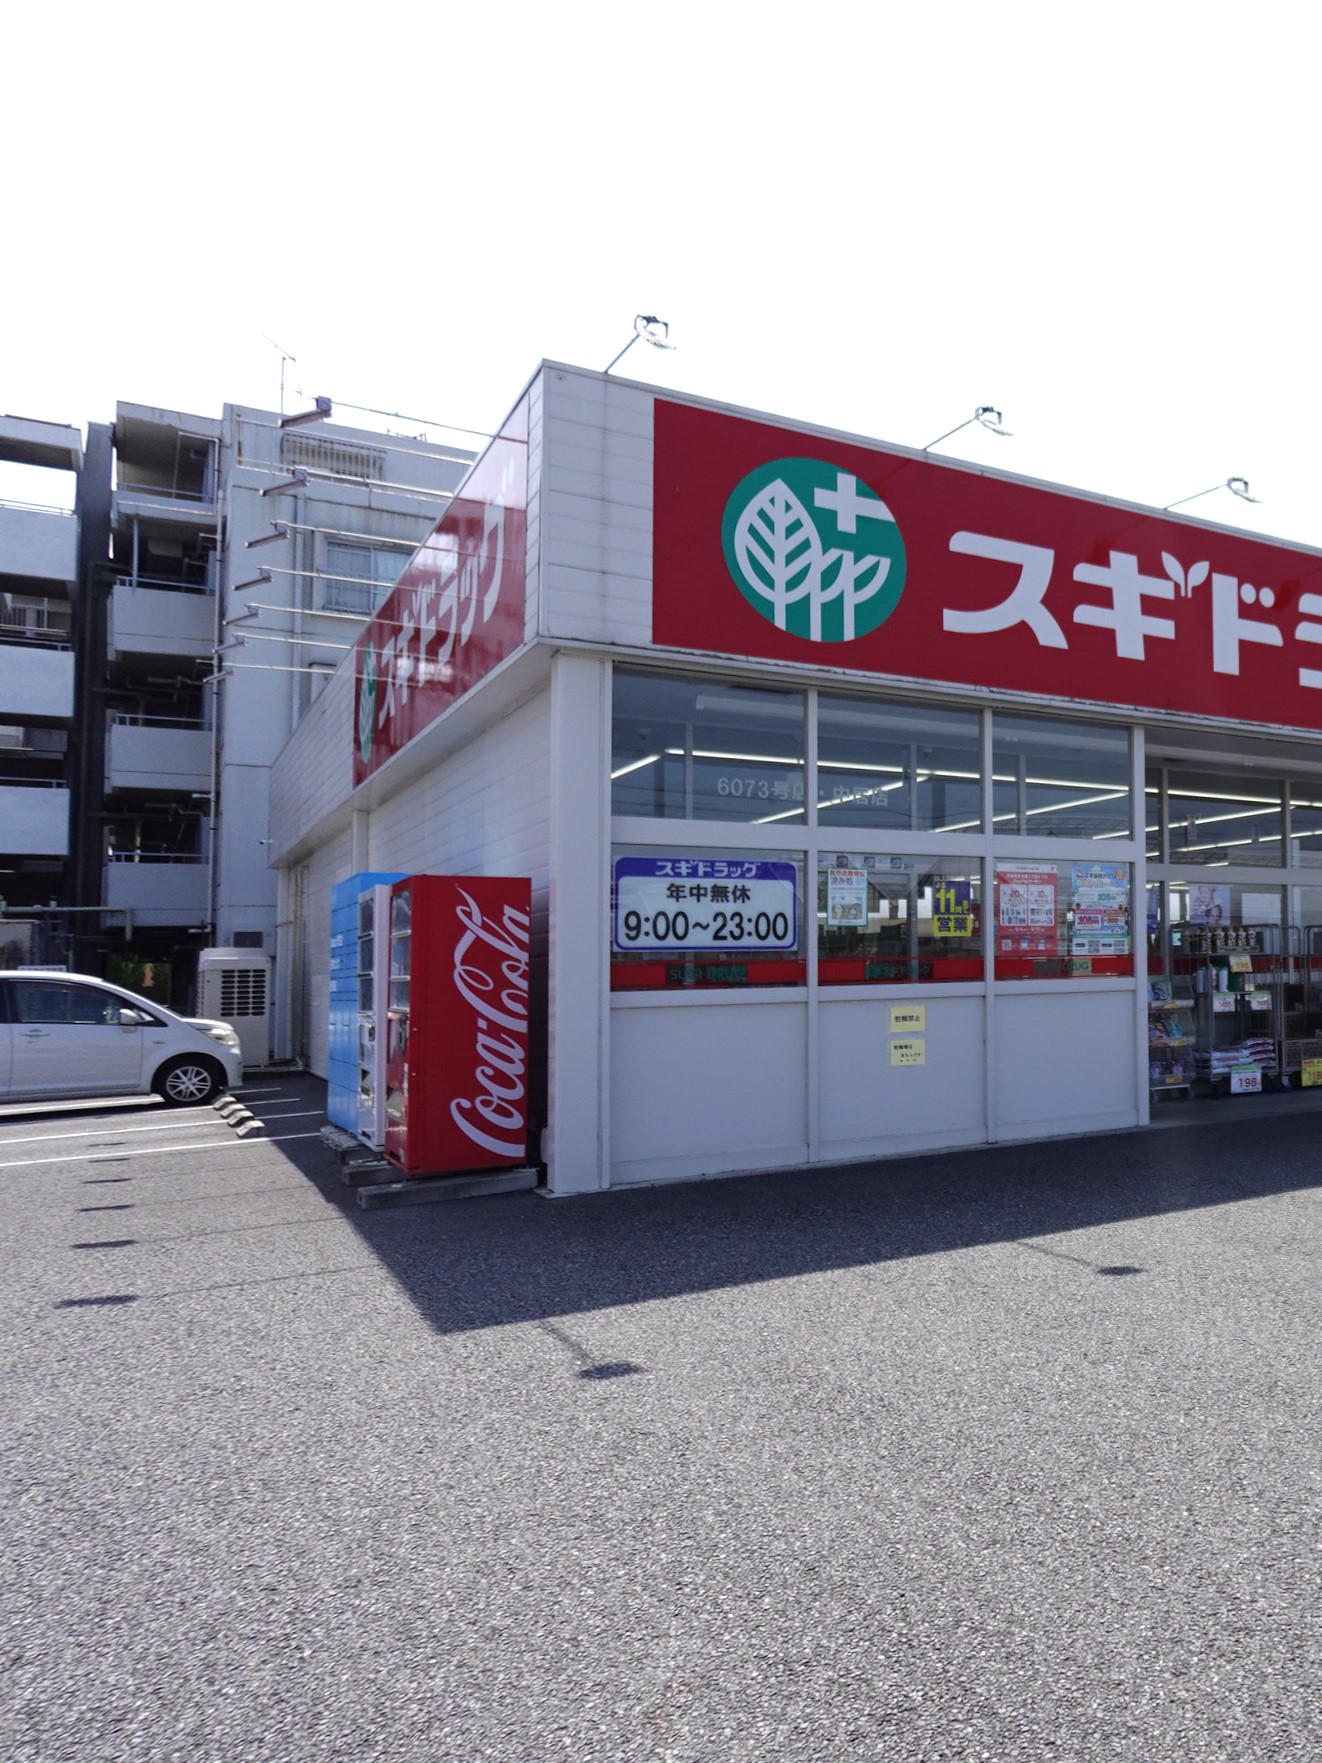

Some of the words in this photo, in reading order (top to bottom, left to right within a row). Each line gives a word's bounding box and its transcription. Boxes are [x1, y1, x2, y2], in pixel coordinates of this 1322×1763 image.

[379, 458, 515, 729] スギドラッグ
[655, 860, 760, 878] スギドラッグ
[666, 883, 752, 904] 年中無休
[937, 916, 968, 933] 営業
[1238, 1077, 1258, 1089] 198
